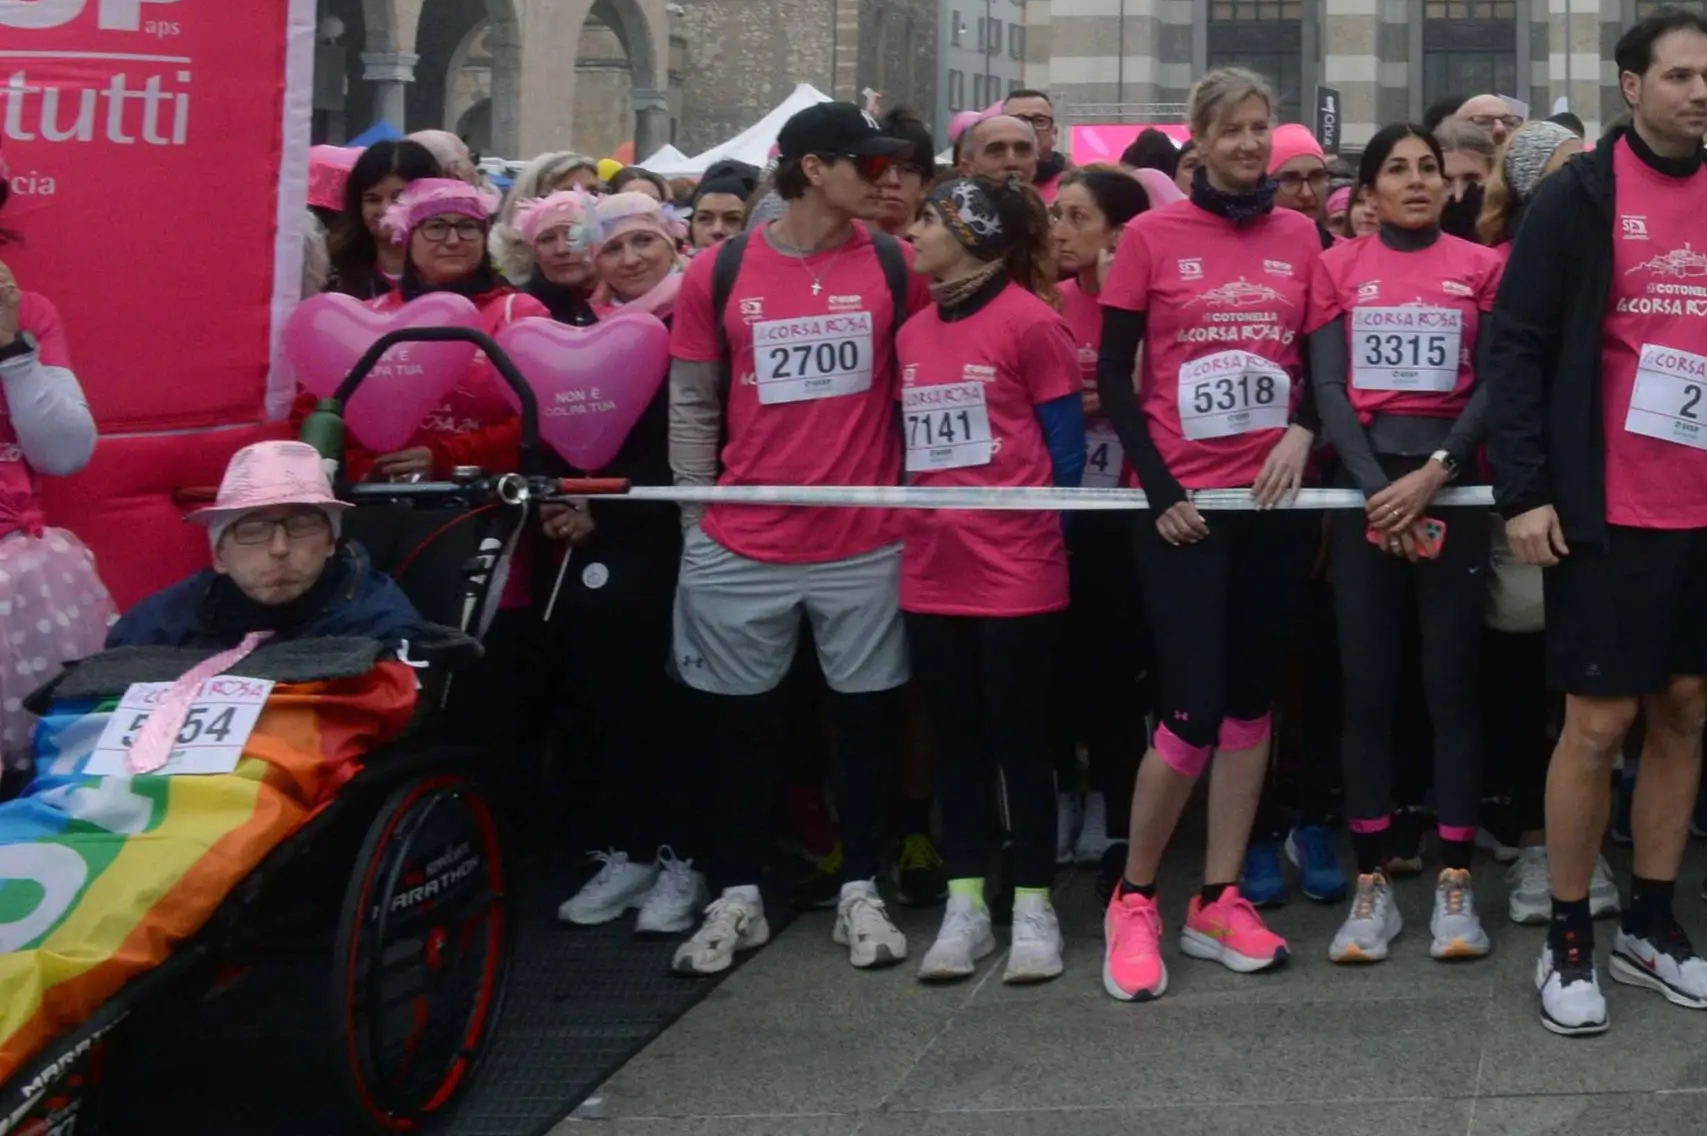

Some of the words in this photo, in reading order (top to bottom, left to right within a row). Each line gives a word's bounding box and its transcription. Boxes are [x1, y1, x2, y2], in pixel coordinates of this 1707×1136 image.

[144, 20, 181, 39] aps
[1628, 298, 1682, 315] CORSA
[768, 322, 821, 340] CORSA
[1189, 327, 1238, 342] CORSA
[769, 340, 859, 379] 2700
[1365, 334, 1446, 367] 3315
[1655, 353, 1705, 376] CORSA
[555, 389, 586, 403] NON
[1194, 376, 1275, 413] 5318
[1680, 384, 1701, 419] 2
[908, 410, 971, 446] 7141
